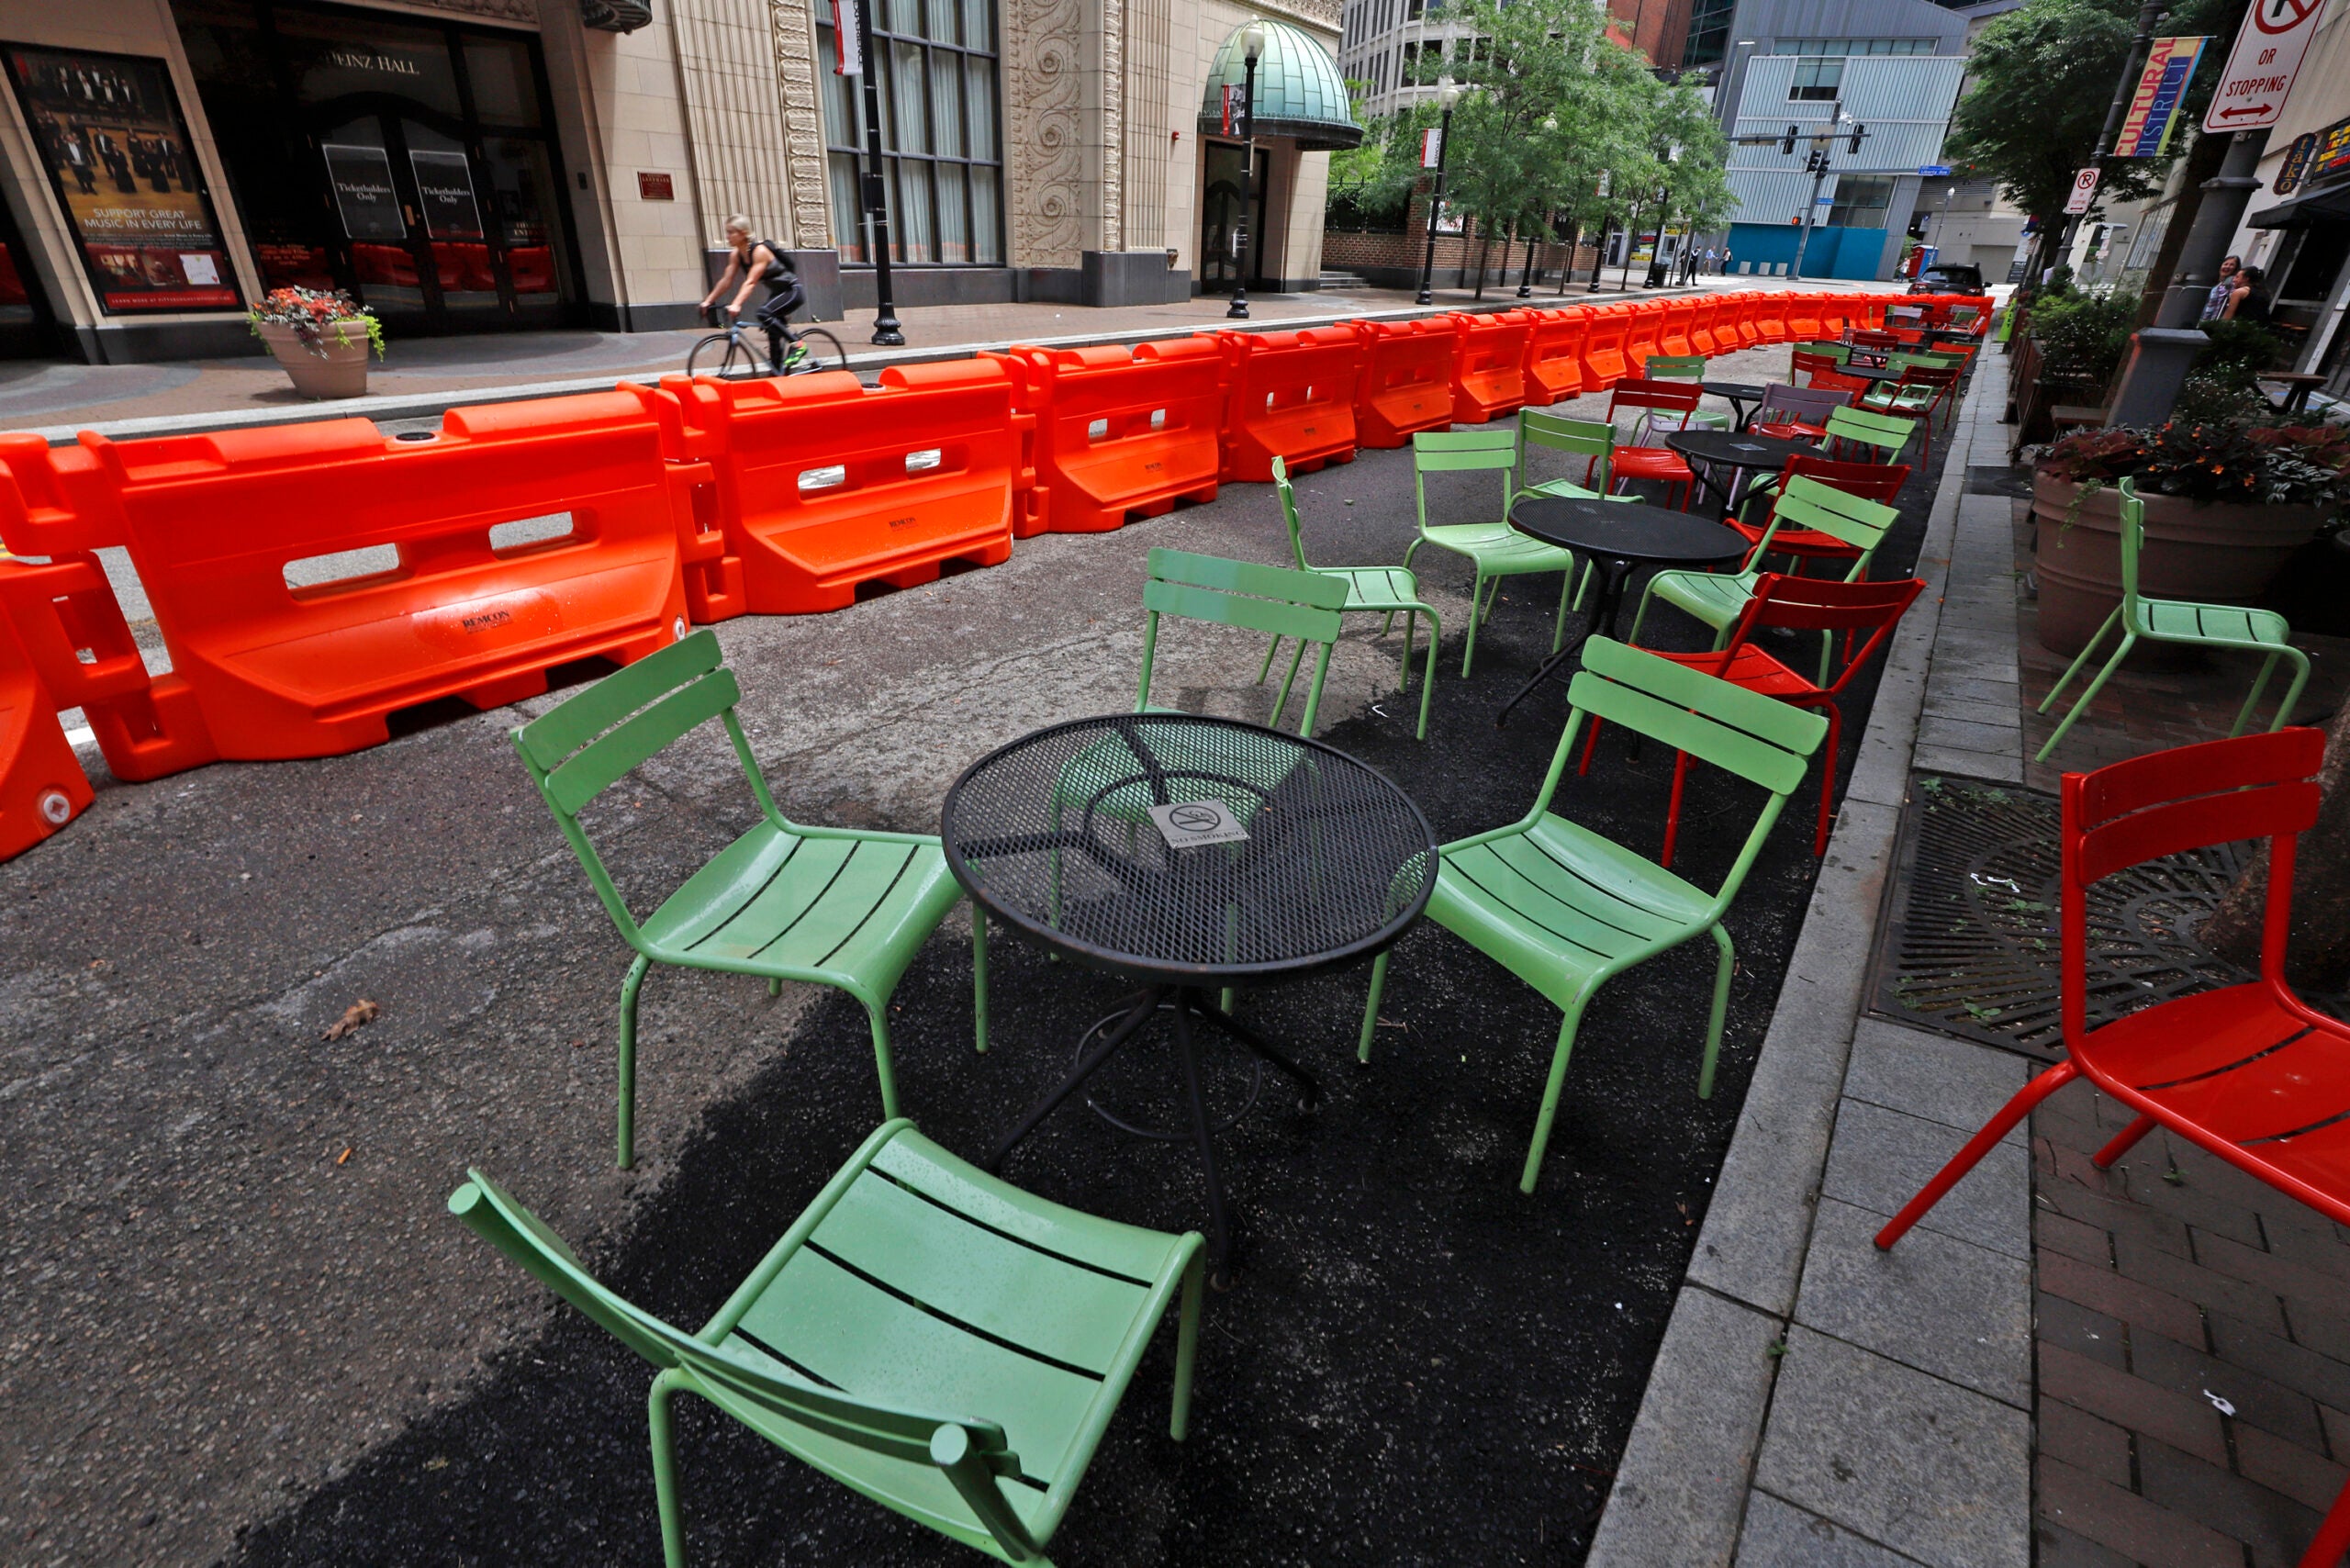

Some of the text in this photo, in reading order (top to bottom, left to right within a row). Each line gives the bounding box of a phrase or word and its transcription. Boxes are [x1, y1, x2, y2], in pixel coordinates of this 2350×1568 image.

[2258, 48, 2277, 65] OR
[377, 56, 420, 75] HALL
[2225, 74, 2288, 97] STOPPING
[2115, 37, 2177, 157] CULTURAL
[2134, 61, 2188, 157] DISTRICT
[337, 184, 392, 194] Ticketholders
[421, 186, 471, 196] Ticketholders
[356, 193, 378, 203] Only
[439, 195, 459, 205] Only
[93, 208, 185, 220] SUPPORT GREAT
[84, 218, 202, 230] MUSIC IN EVERY LIFE
[463, 610, 510, 628] REMCON
[1190, 830, 1245, 843] SMOKING
